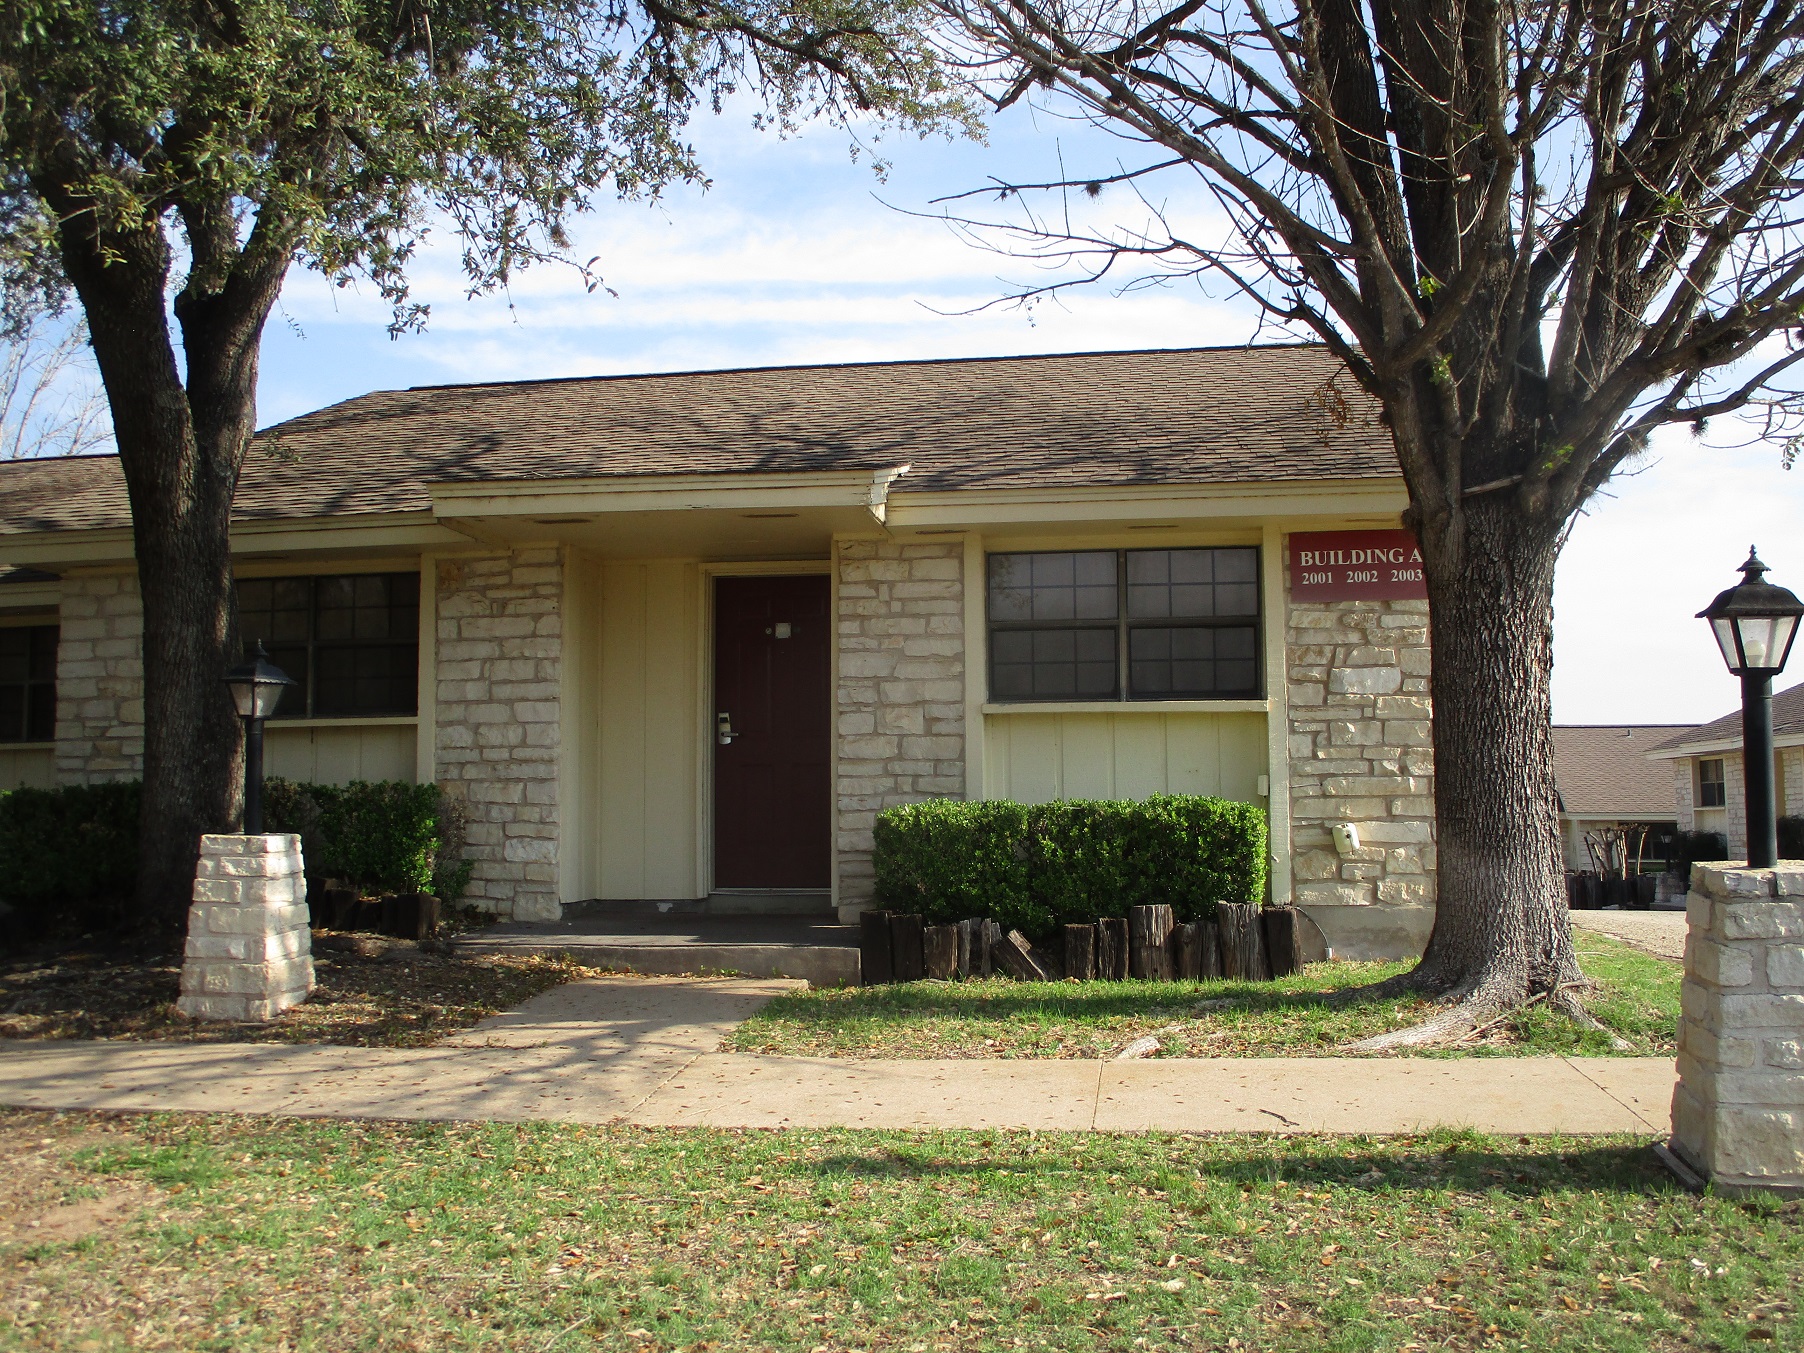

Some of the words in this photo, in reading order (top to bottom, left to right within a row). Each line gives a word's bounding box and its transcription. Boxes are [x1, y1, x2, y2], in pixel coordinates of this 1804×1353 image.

[1299, 547, 1405, 567] BUILDING
[1409, 547, 1423, 564] A
[1301, 571, 1334, 585] 2001
[1346, 570, 1379, 583] 2002
[1390, 569, 1423, 582] 2003
